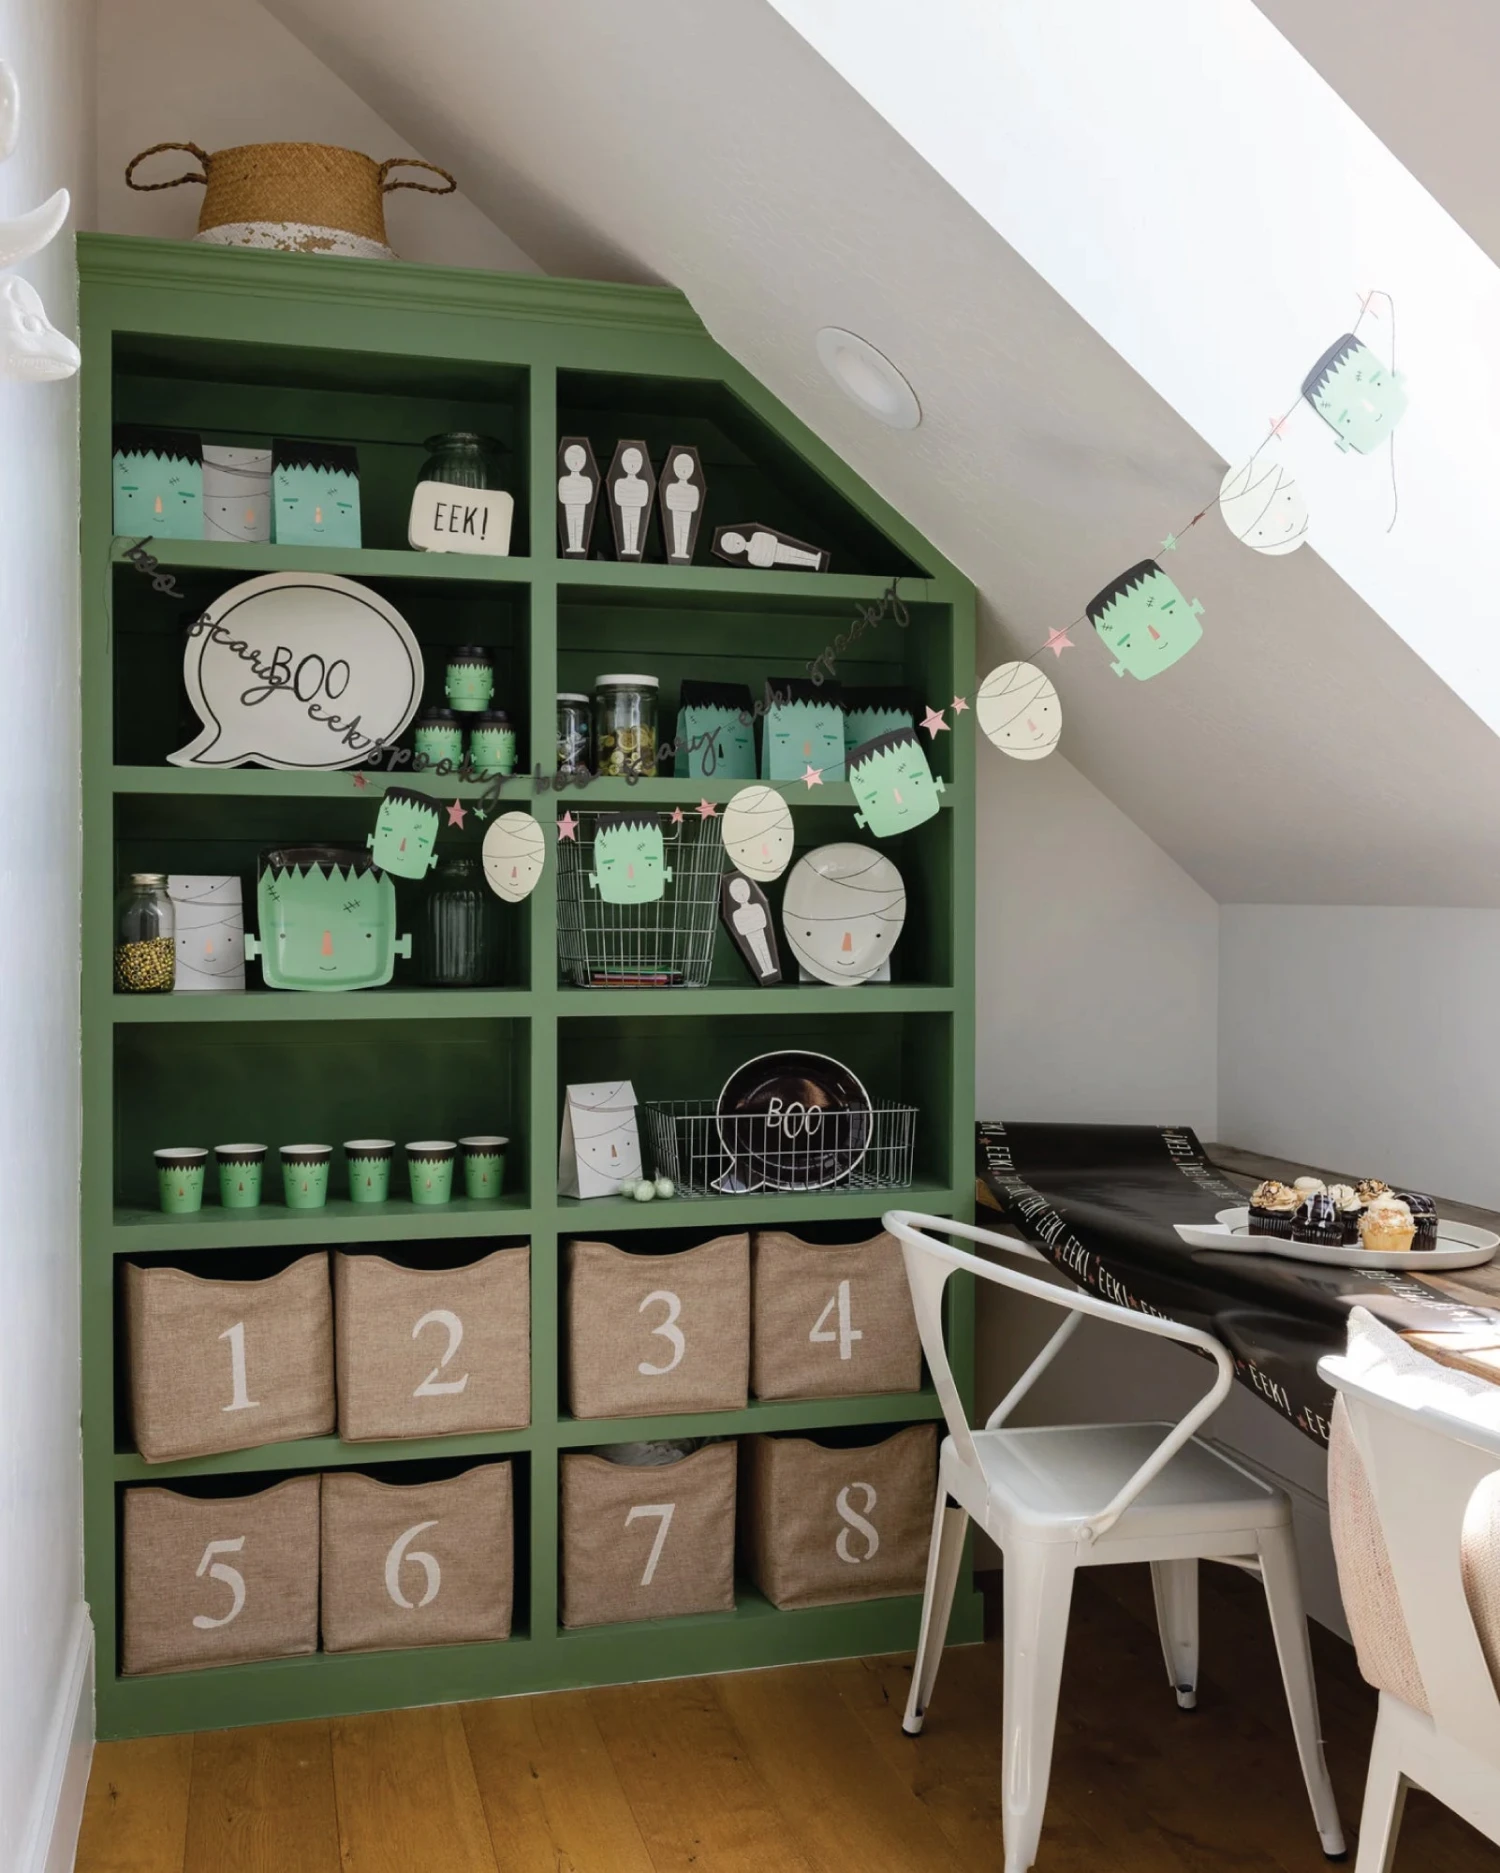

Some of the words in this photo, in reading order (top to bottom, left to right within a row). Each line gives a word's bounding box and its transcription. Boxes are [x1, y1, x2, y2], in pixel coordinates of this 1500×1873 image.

[433, 502, 489, 541] EEK!
[122, 535, 185, 599] boo
[186, 611, 298, 707] scary
[307, 703, 372, 750] eek
[368, 737, 517, 813] spooky
[271, 645, 351, 703] BOO
[766, 1096, 823, 1139] BOO
[1160, 1132, 1195, 1156] EEK!
[809, 1278, 864, 1361] 4
[985, 1145, 1016, 1171] EEK!
[1018, 1195, 1051, 1223] EEK!
[1035, 1210, 1067, 1251] EEK!
[1063, 1234, 1090, 1282] EEK!
[1248, 1363, 1292, 1417] EEK!
[217, 1321, 261, 1413] 1
[412, 1308, 470, 1398] 2
[637, 1289, 687, 1376] 3
[383, 1519, 442, 1610] 6
[623, 1502, 677, 1587] 7
[834, 1481, 880, 1565] 8
[191, 1535, 247, 1630] 5
